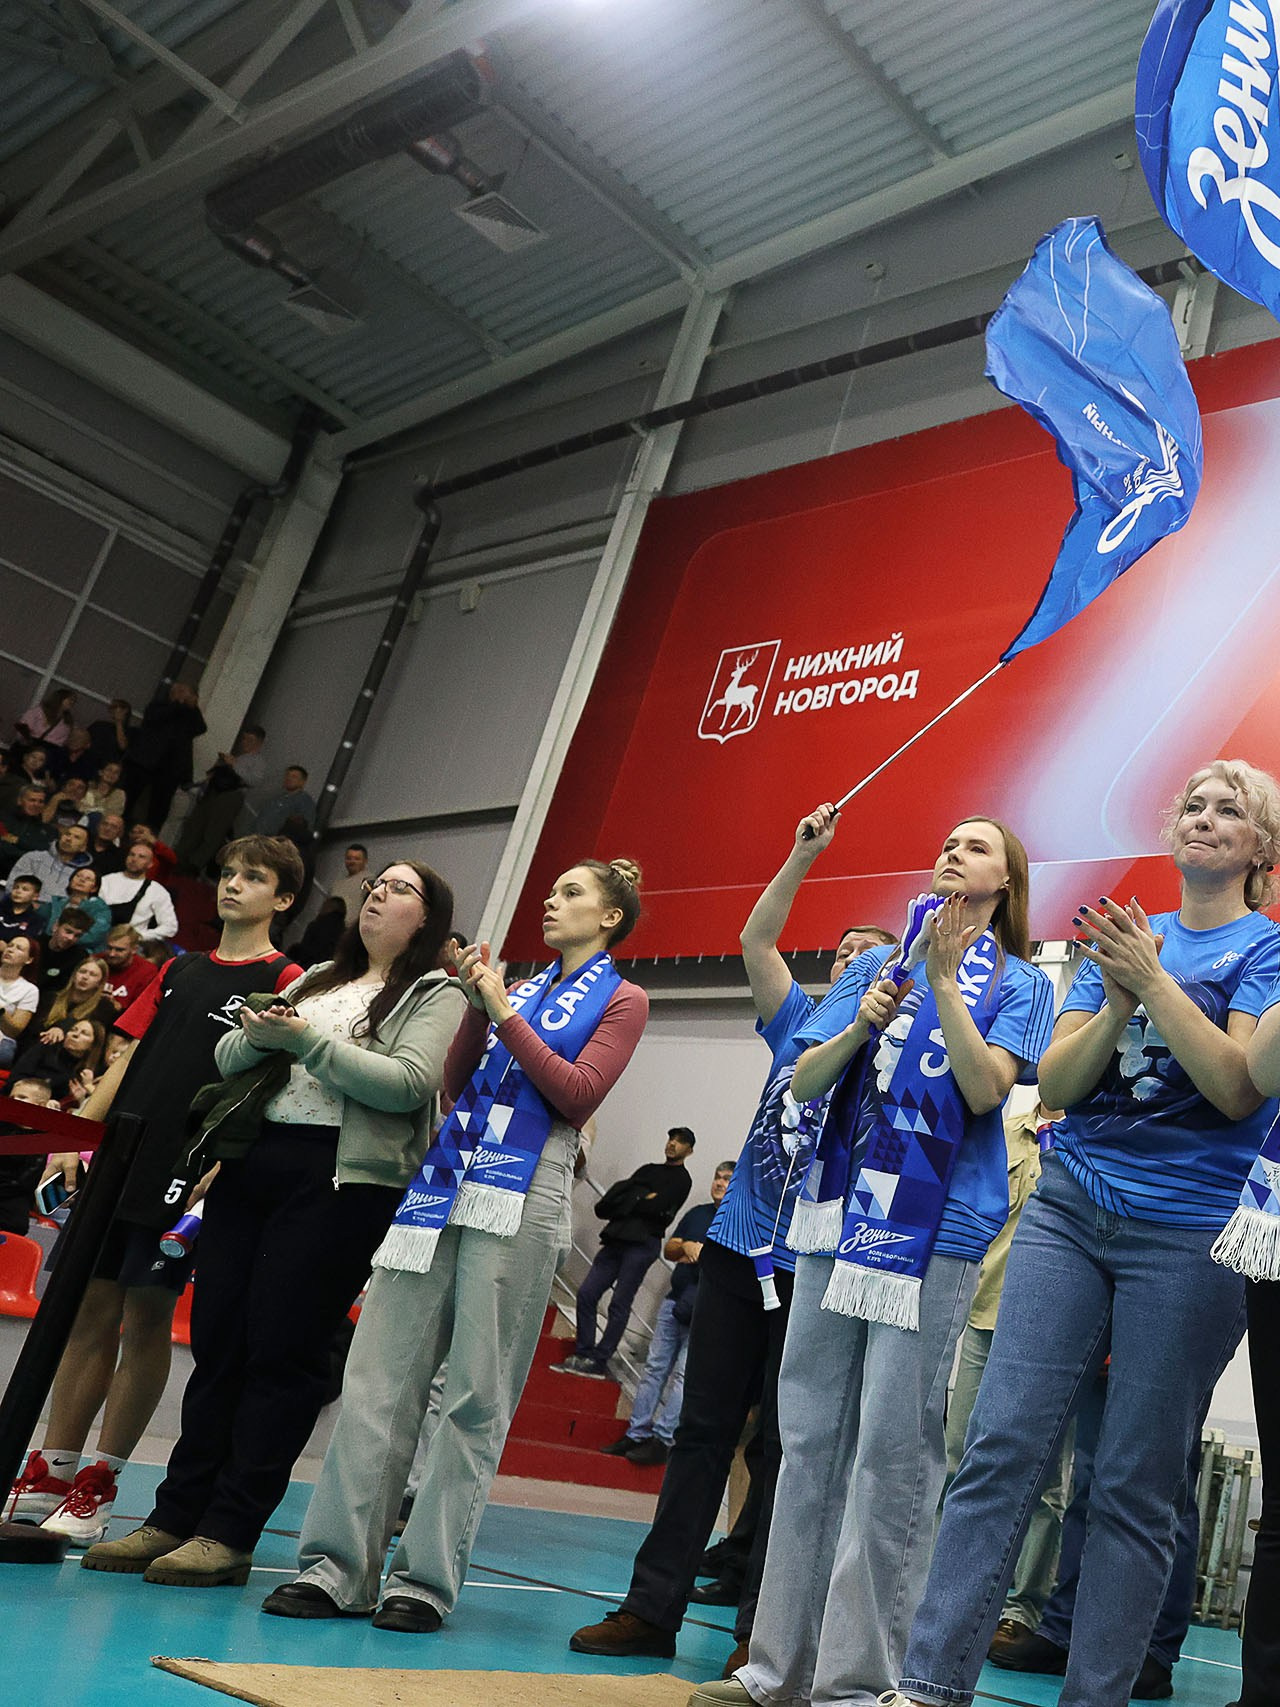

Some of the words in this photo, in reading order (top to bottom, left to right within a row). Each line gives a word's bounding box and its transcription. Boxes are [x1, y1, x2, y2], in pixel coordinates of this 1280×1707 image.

[783, 631, 905, 682] НИЖНИЙ
[773, 669, 921, 716] НОВГОРОД
[164, 1178, 187, 1205] 5
[839, 1222, 916, 1254] Зенит
